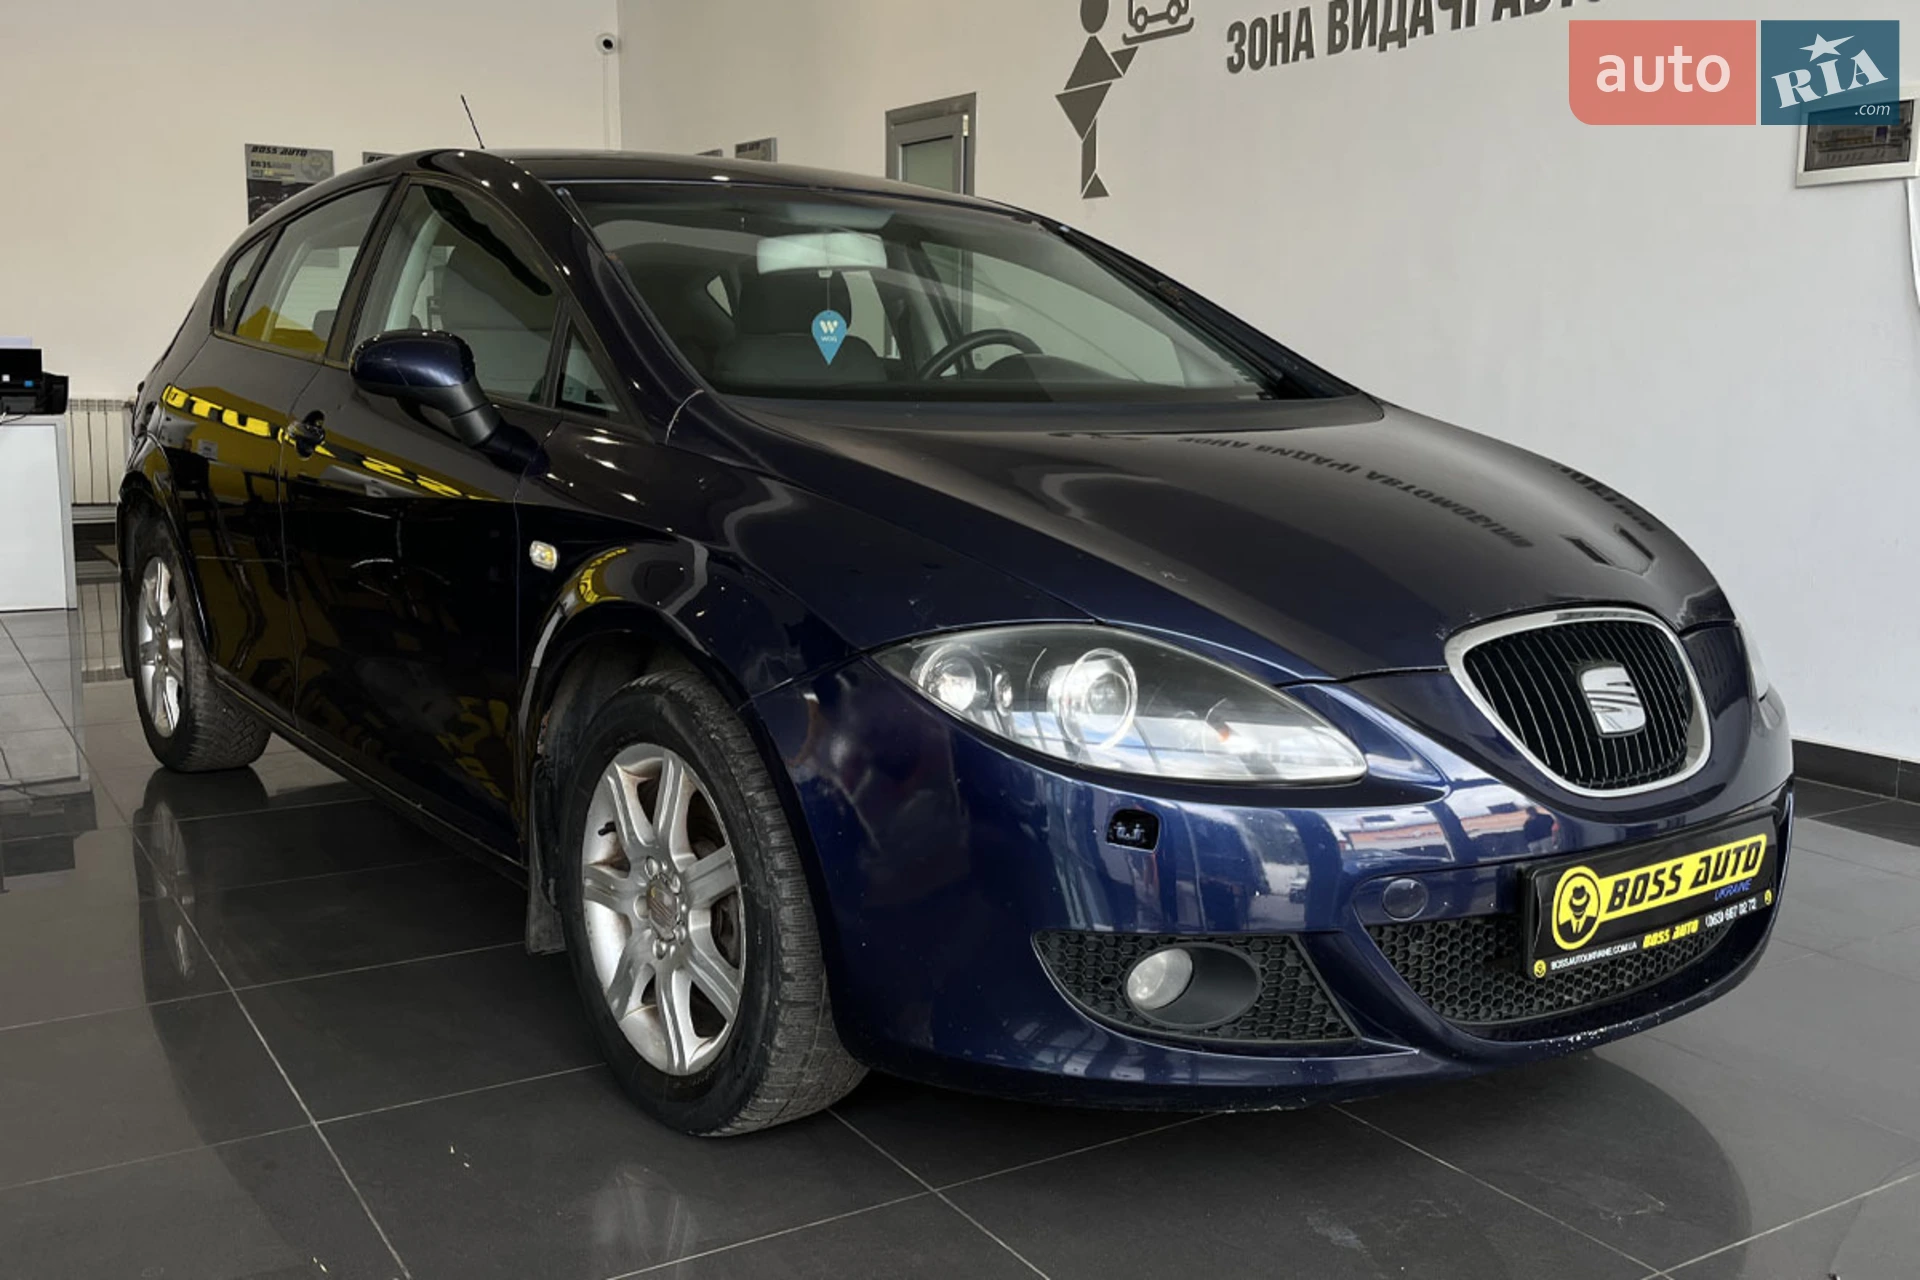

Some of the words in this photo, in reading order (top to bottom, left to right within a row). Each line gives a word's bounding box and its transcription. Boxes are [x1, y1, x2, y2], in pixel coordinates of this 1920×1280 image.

[1227, 20, 1314, 74] ЗОНА
[1607, 862, 1683, 915] BOSS
[1689, 842, 1763, 890] AUTO
